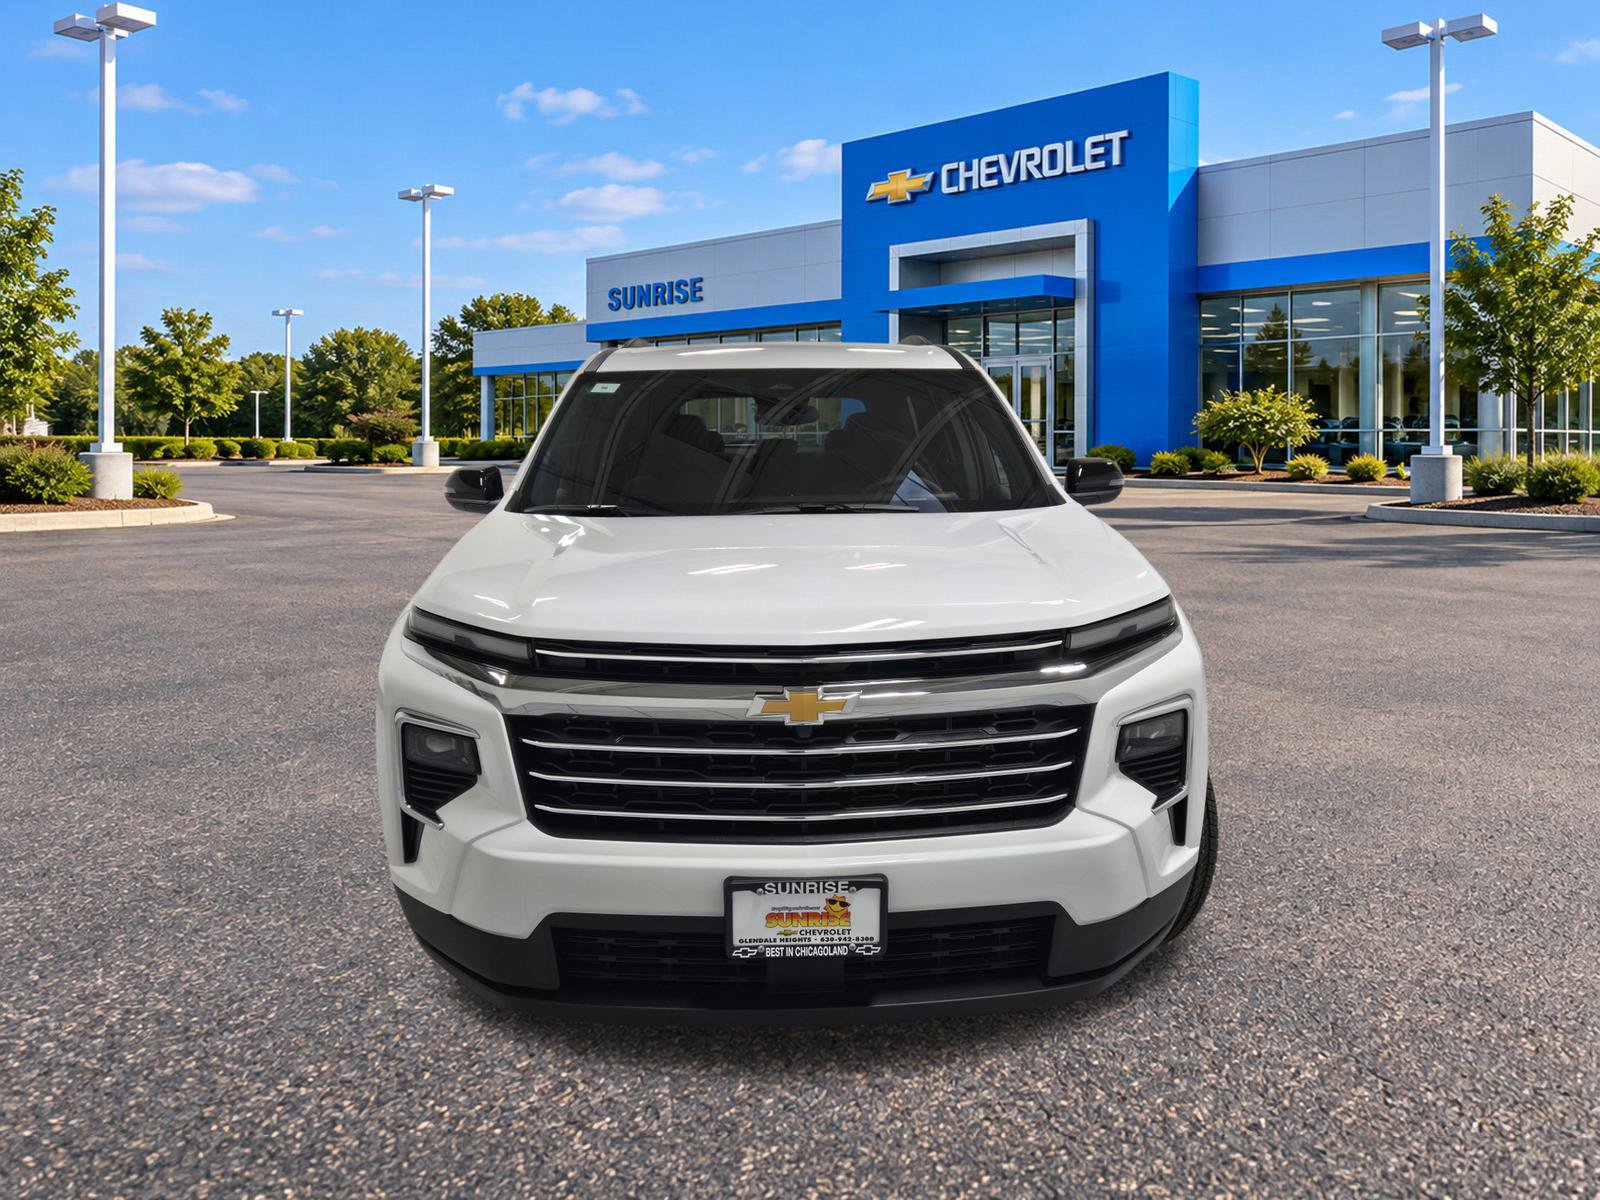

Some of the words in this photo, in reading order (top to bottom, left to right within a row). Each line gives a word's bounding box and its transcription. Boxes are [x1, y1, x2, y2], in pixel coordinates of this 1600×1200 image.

[941, 130, 1129, 194] CHEVROLET
[608, 277, 704, 312] SUNRISE
[764, 881, 849, 895] SUNRISE
[765, 911, 852, 928] SUNRISE
[765, 947, 784, 957] BEST
[785, 946, 794, 957] IN
[795, 945, 849, 957] CHICAGOLAND
